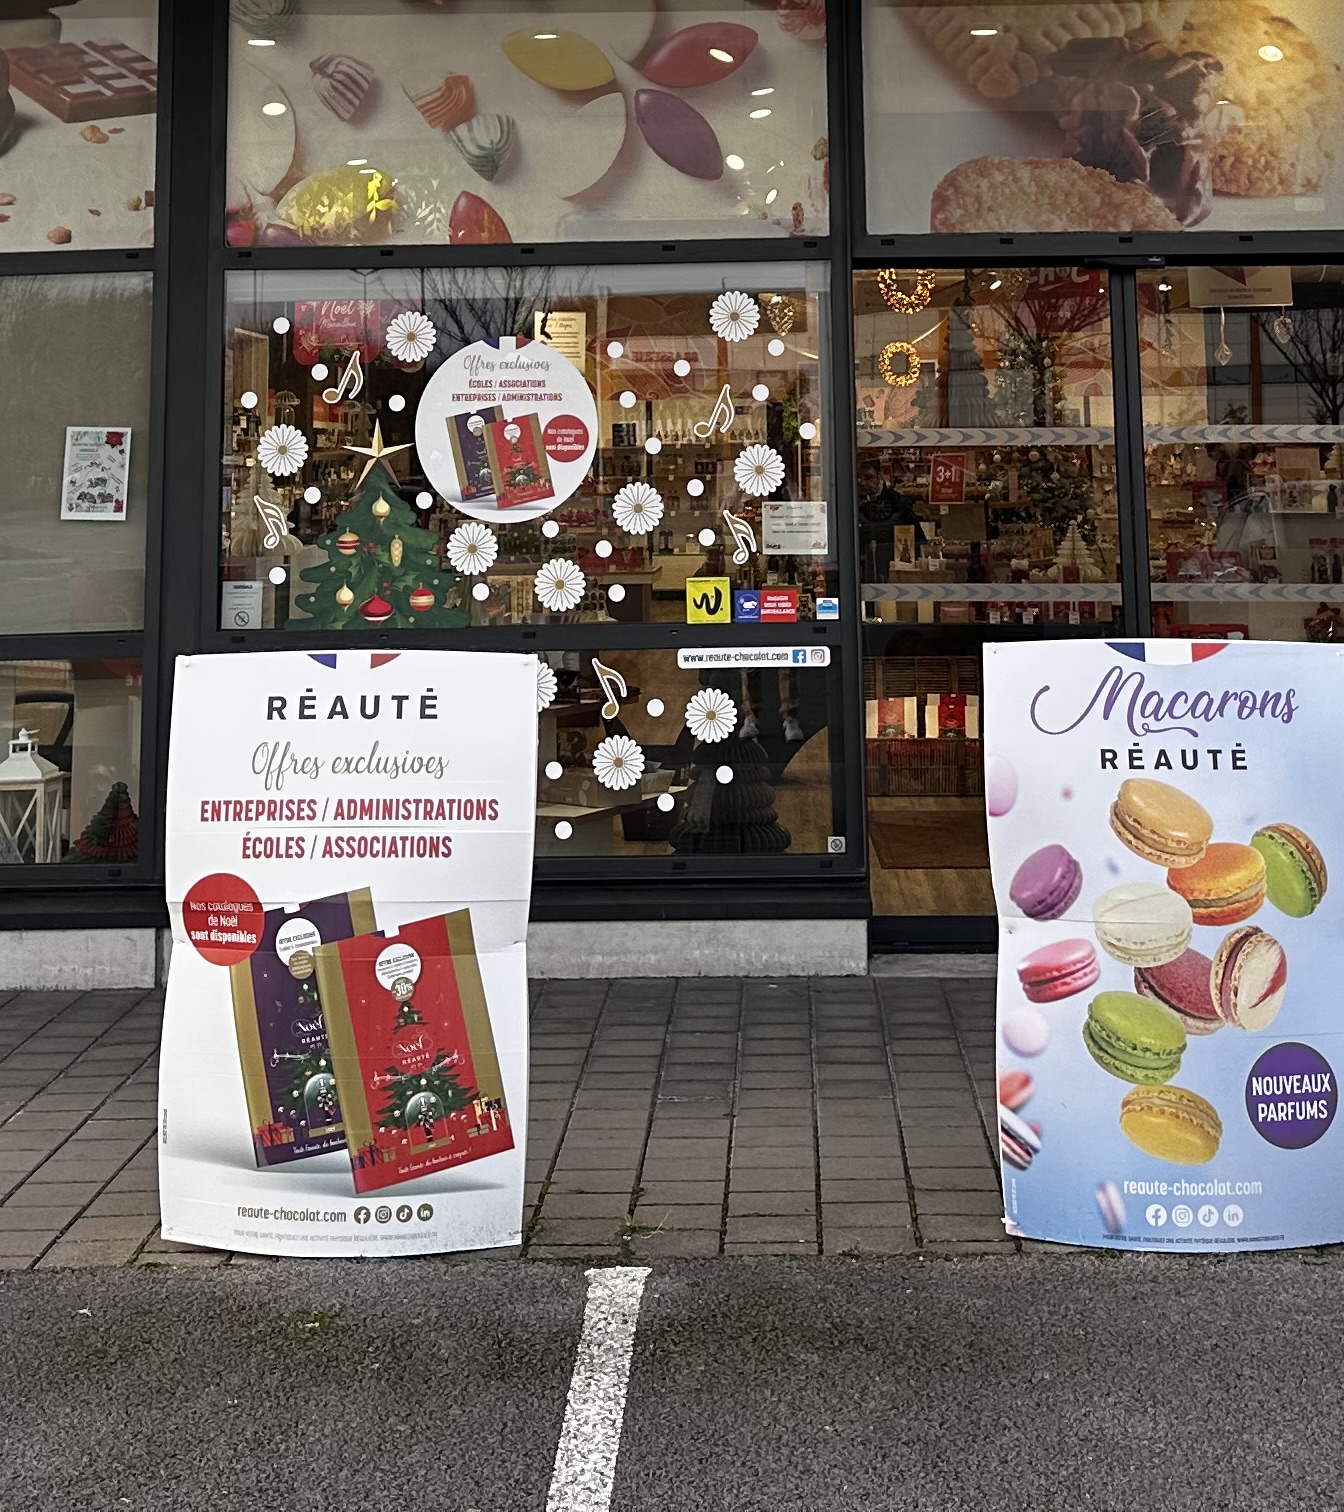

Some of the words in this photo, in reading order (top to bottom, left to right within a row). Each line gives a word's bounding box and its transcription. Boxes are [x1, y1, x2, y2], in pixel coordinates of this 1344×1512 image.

[463, 354, 497, 376] Offres
[499, 354, 552, 372] exclusives
[682, 651, 789, 663] www.reaute-chocolat.com
[266, 688, 439, 721] RÉAUTÉ
[1030, 665, 1300, 737] Macarons
[252, 740, 325, 791] Offres
[331, 740, 451, 780] exclusives
[1100, 742, 1248, 771] RÉAUTÉ
[200, 799, 317, 822] ENTREPRISES
[333, 798, 499, 822] ADMINISTRATIONS
[242, 831, 306, 859] ÉCOLES
[322, 835, 453, 859] ASSOCIATIONS
[191, 929, 209, 943] sont
[210, 929, 257, 947] disponibles
[1251, 1073, 1332, 1096] NOUVEAUX
[1258, 1100, 1329, 1122] PARFUMS
[1123, 1179, 1263, 1197] reaute-chocolat.com
[237, 1205, 347, 1223] reaute-chocolat.com
